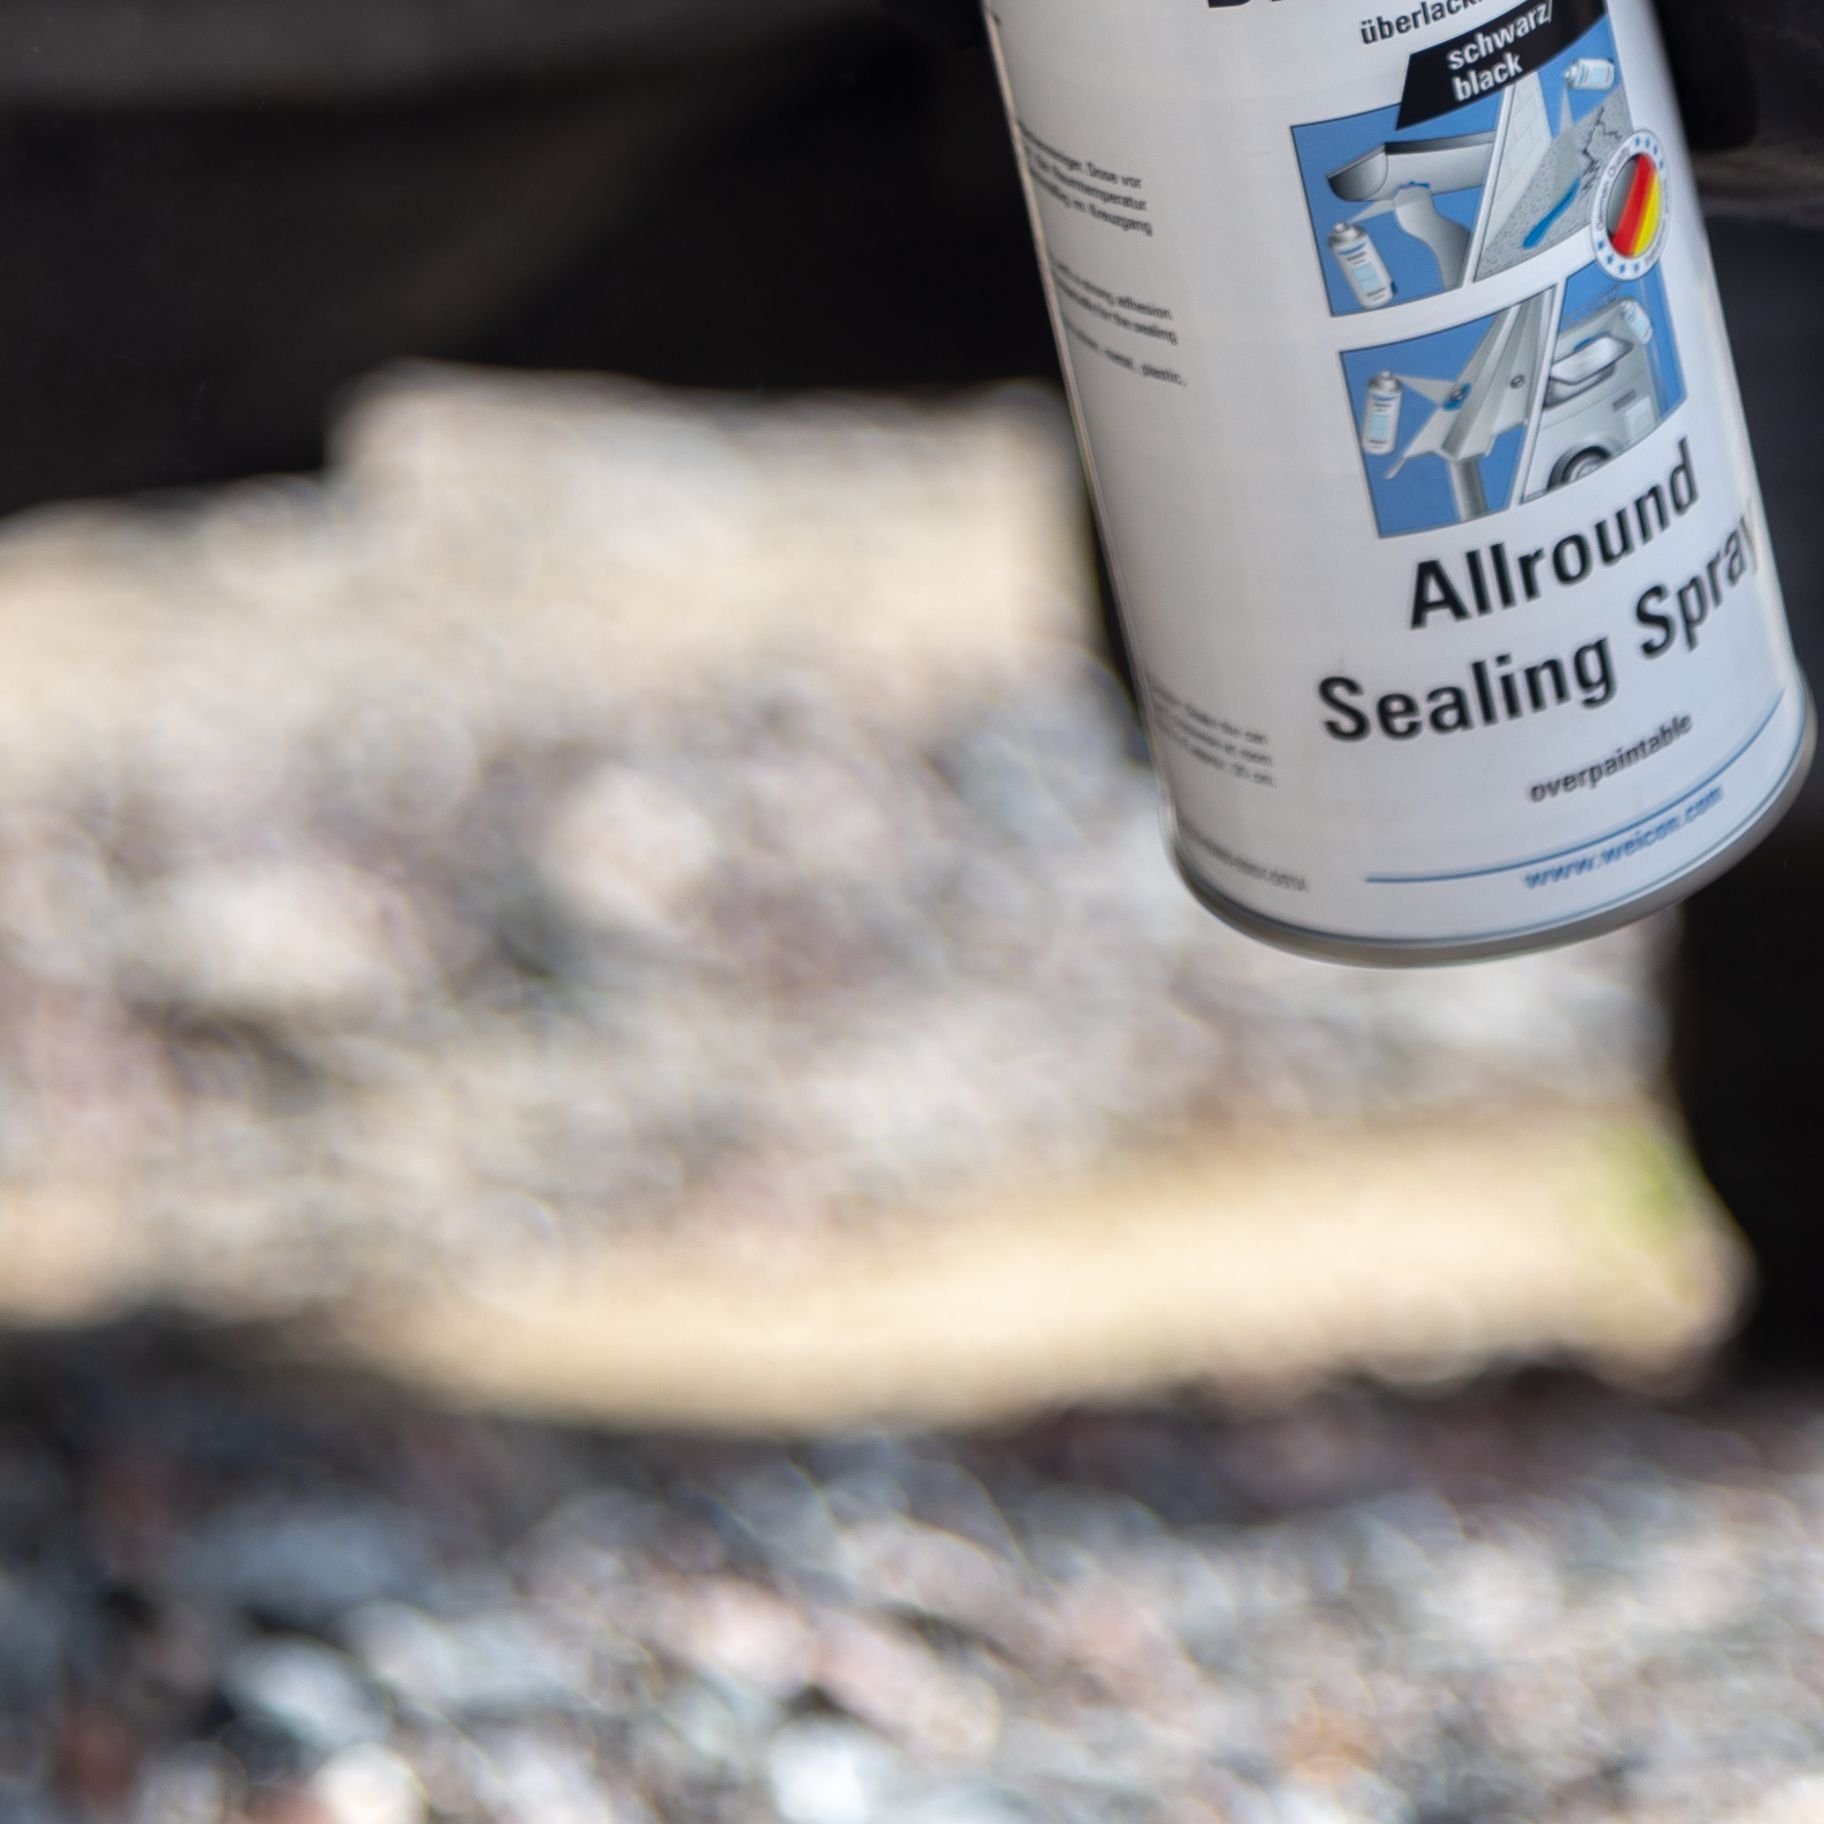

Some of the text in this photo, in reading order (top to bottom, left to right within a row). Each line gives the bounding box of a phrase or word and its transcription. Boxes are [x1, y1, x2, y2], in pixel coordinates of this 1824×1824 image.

[1452, 51, 1523, 101] black
[1409, 435, 1699, 631] Allround
[1317, 496, 1758, 742] Sealing Spray
[1529, 713, 1693, 803] overpaintable
[1523, 785, 1723, 890] www.weicon.com
